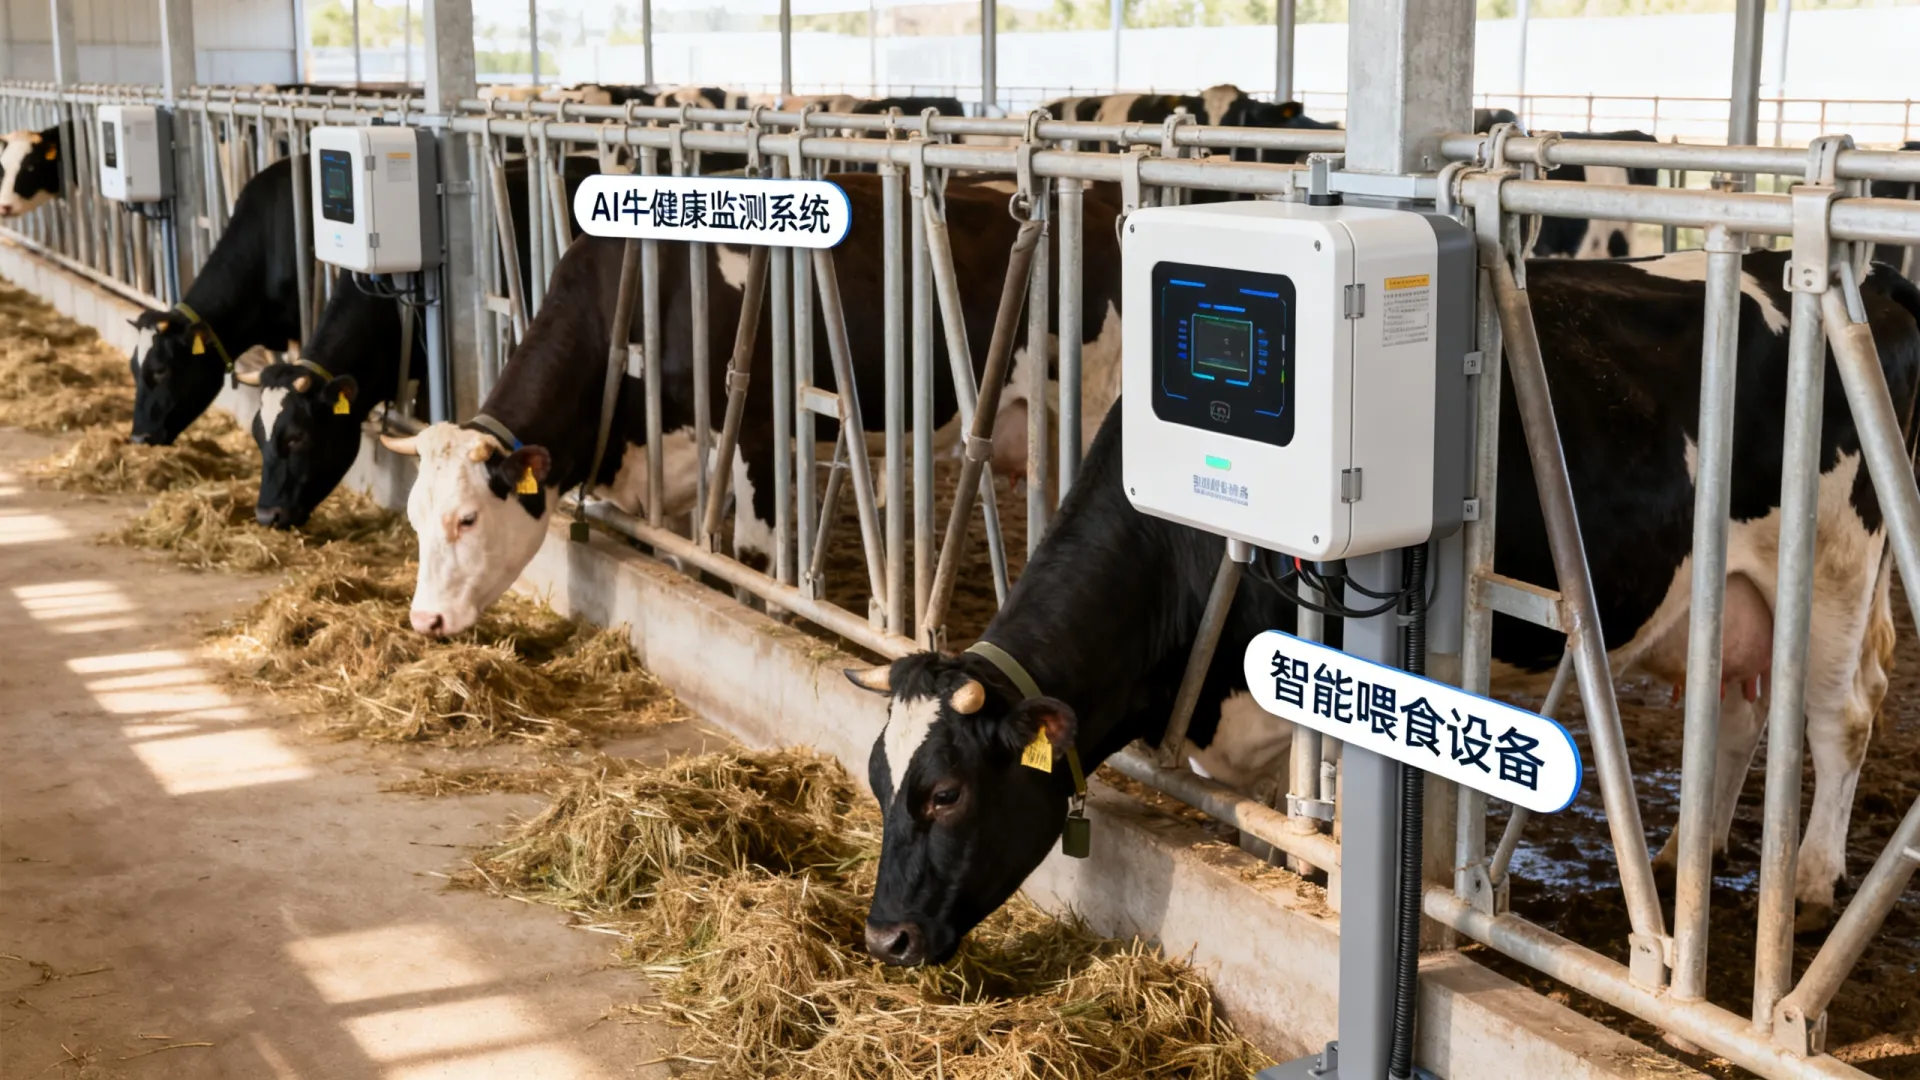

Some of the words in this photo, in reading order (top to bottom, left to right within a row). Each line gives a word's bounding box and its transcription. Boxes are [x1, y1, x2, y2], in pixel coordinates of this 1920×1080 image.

[591, 188, 831, 234] AI牛健康监测系统
[1270, 649, 1545, 791] 智能喂食设备
